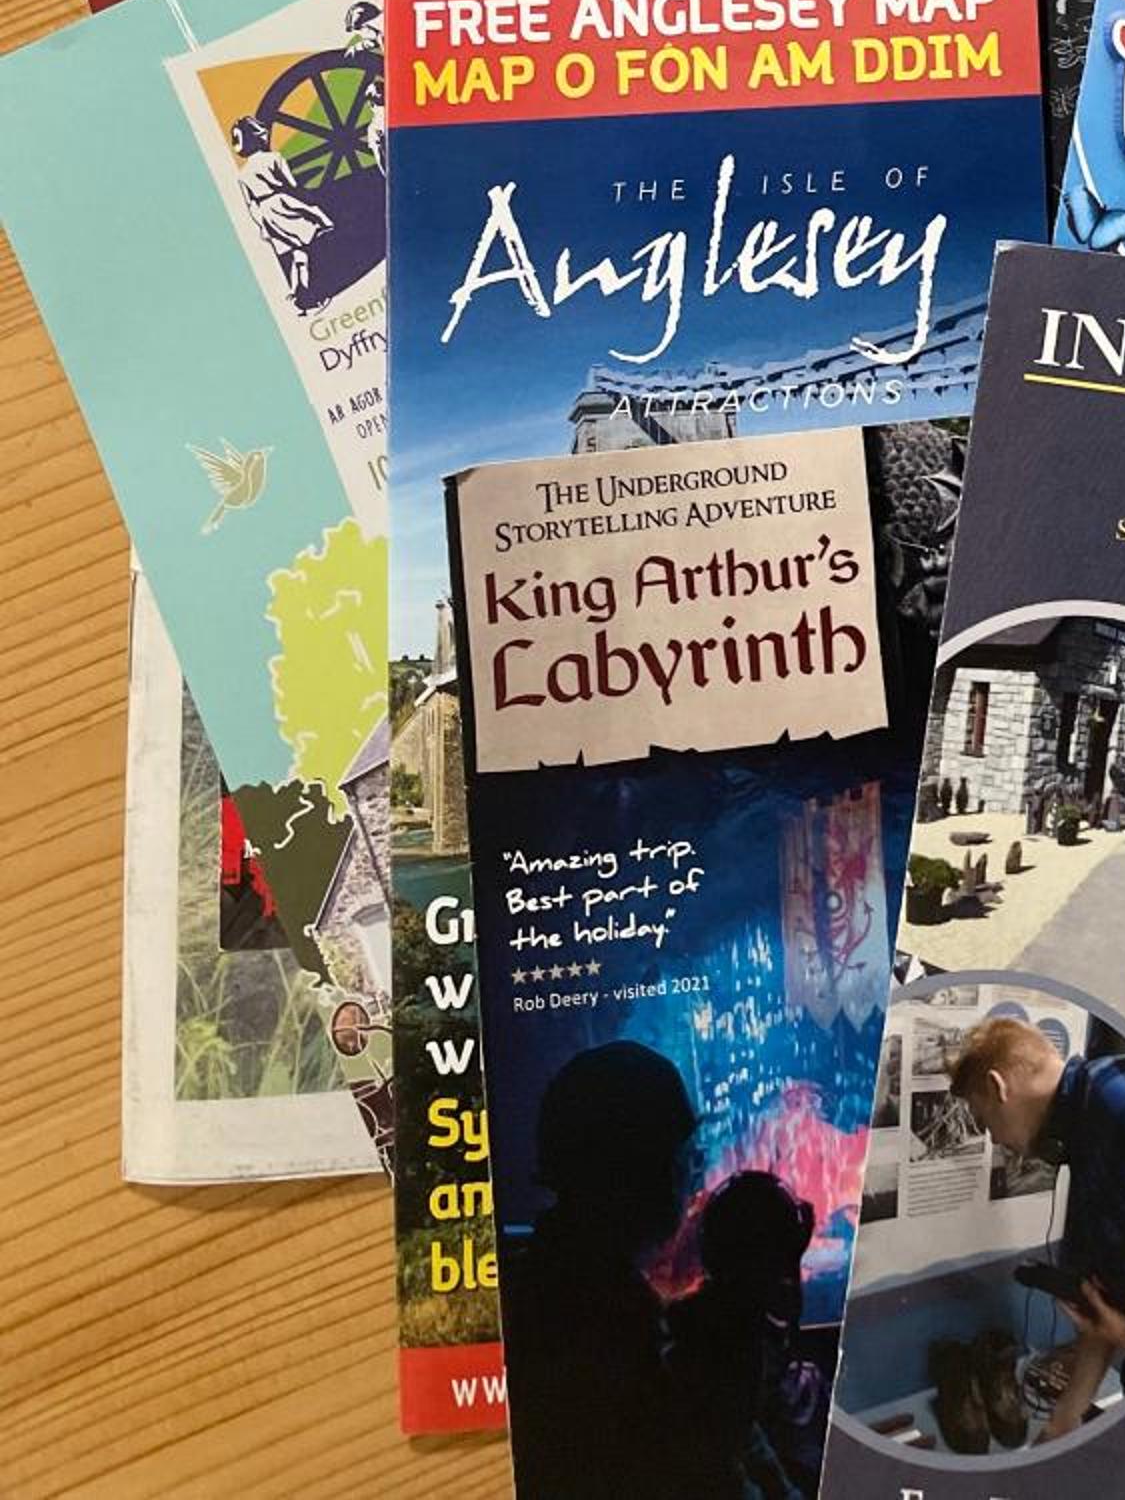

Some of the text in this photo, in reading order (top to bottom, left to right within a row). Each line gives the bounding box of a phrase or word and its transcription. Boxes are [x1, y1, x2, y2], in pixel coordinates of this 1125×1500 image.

[413, 53, 535, 107] MAP
[556, 52, 596, 98] O
[748, 39, 834, 90] AM
[853, 31, 1003, 83] DDIM
[612, 165, 930, 204] THE ISLE OF
[440, 153, 948, 365] Anglesey
[309, 288, 387, 342] Green
[609, 379, 904, 421] ATTRACTIONS
[484, 533, 859, 624] King Arthur's
[492, 605, 867, 712] Labyrinth
[628, 837, 697, 870] trip.
[506, 867, 706, 917] Best part of
[509, 926, 563, 952] the
[513, 992, 546, 1013] Rob
[549, 990, 599, 1012] Deery
[613, 982, 668, 1000] visited
[671, 974, 711, 993] 2021
